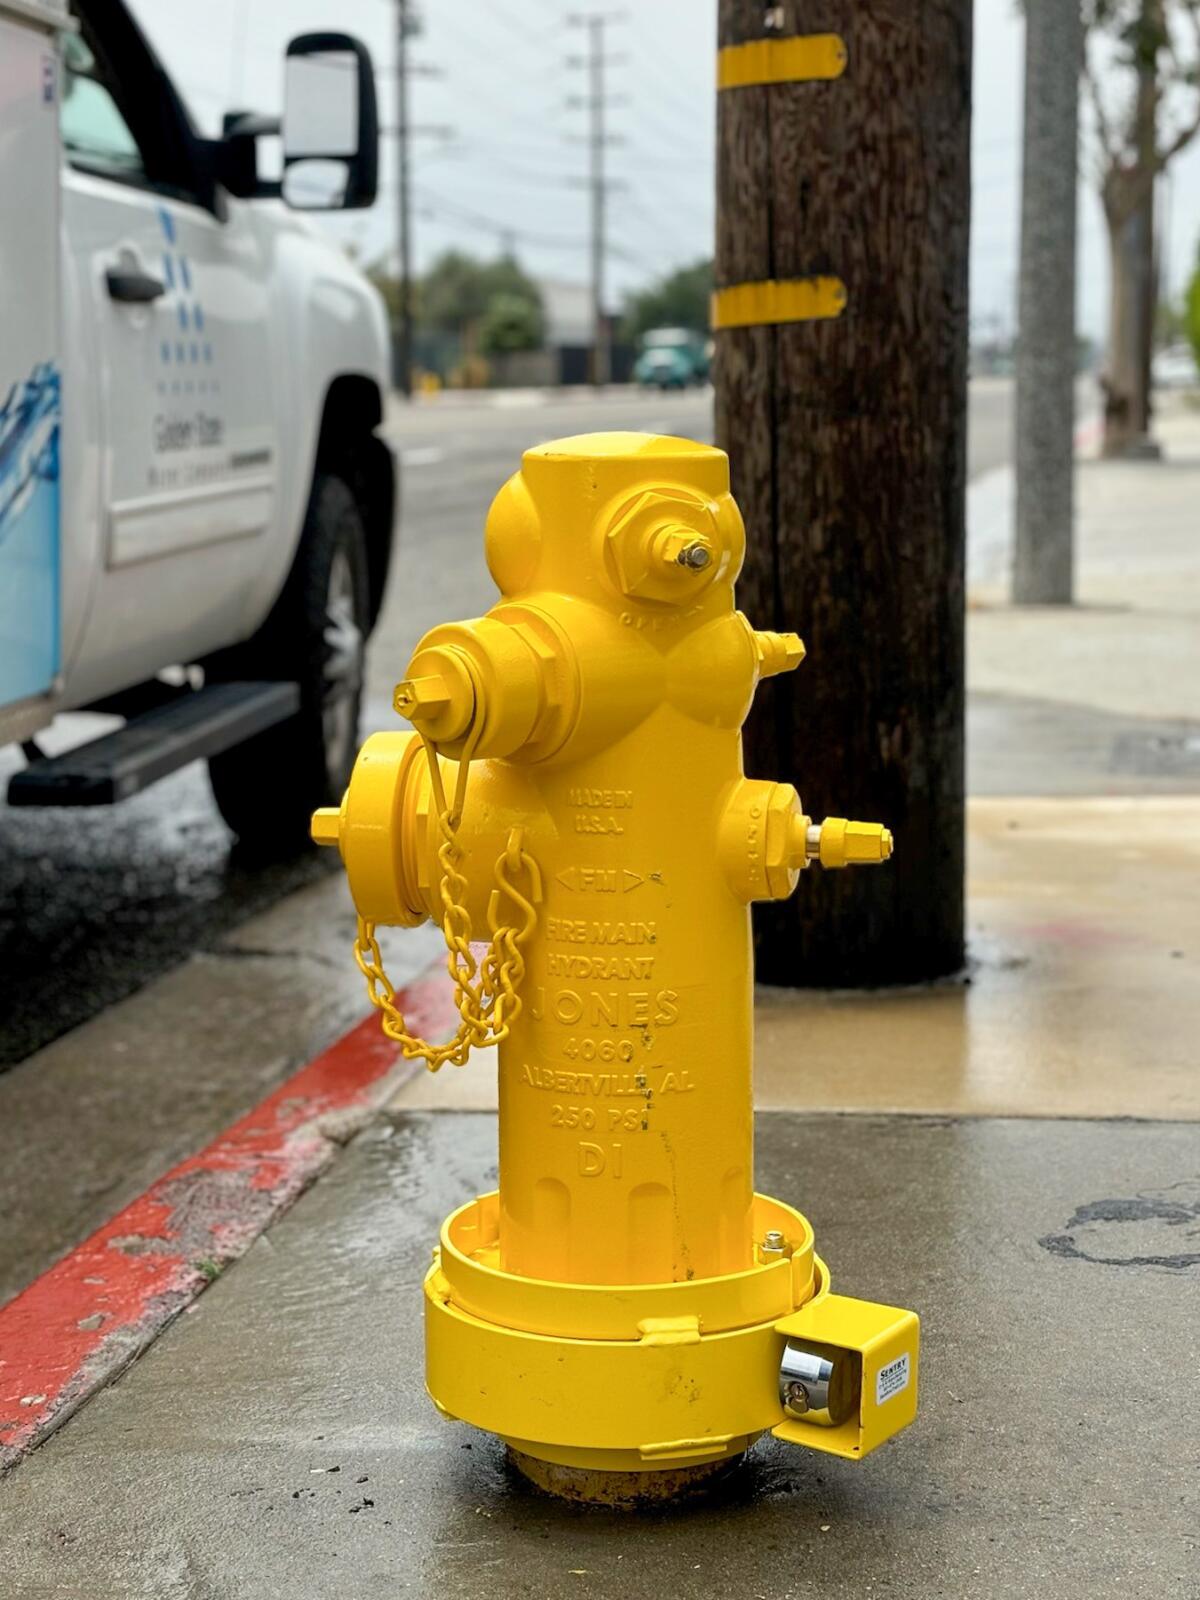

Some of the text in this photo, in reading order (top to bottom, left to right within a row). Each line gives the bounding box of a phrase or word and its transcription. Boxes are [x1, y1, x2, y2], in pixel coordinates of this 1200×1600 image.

[568, 788, 633, 809] MADE IN
[546, 917, 656, 945] FIRE MAIN
[546, 953, 655, 980] HYDRANT
[530, 987, 680, 1029] JONES
[563, 1037, 634, 1062] 4060
[659, 1070, 696, 1094] AL
[551, 1104, 649, 1131] 250 PSI
[578, 1141, 623, 1180] DI
